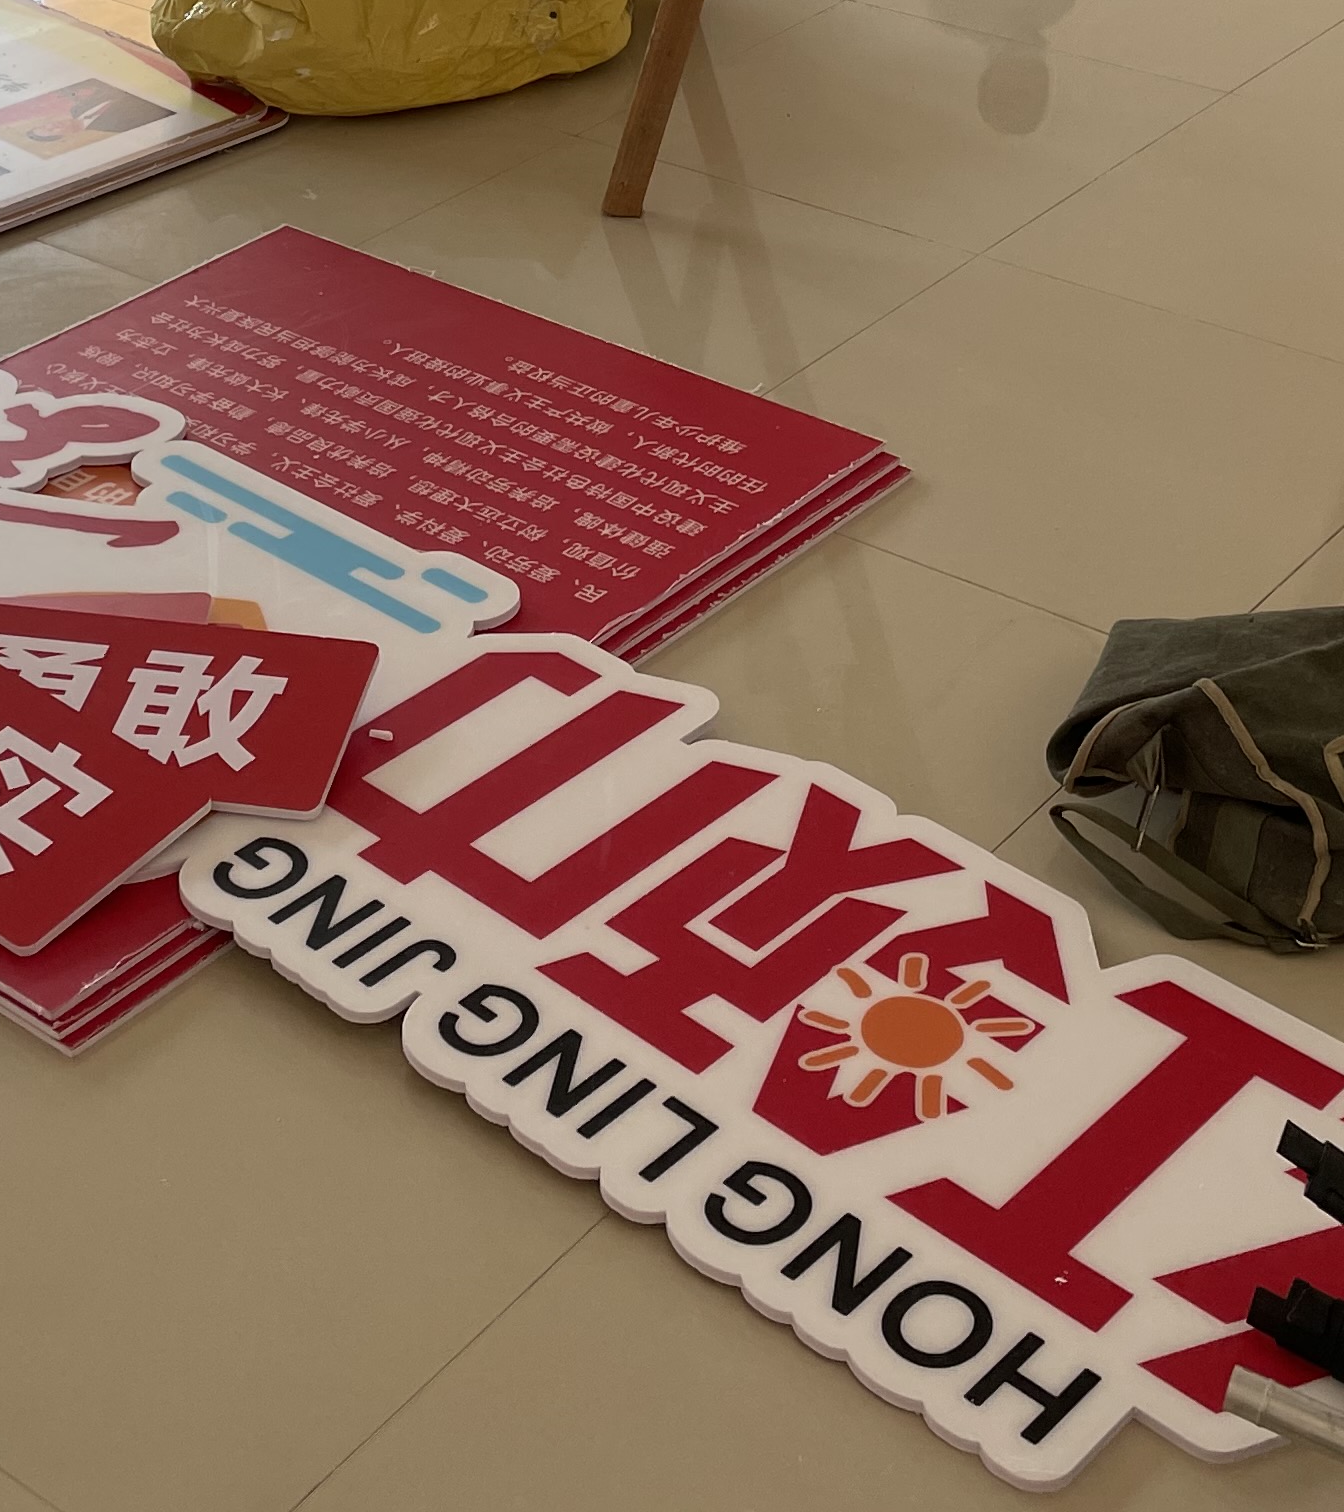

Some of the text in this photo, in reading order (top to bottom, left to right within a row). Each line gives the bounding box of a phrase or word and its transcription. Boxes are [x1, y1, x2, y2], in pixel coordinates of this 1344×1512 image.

[504, 354, 747, 456] 维护少年儿童的正当权益。
[211, 834, 1101, 1447] HONG LING JING
